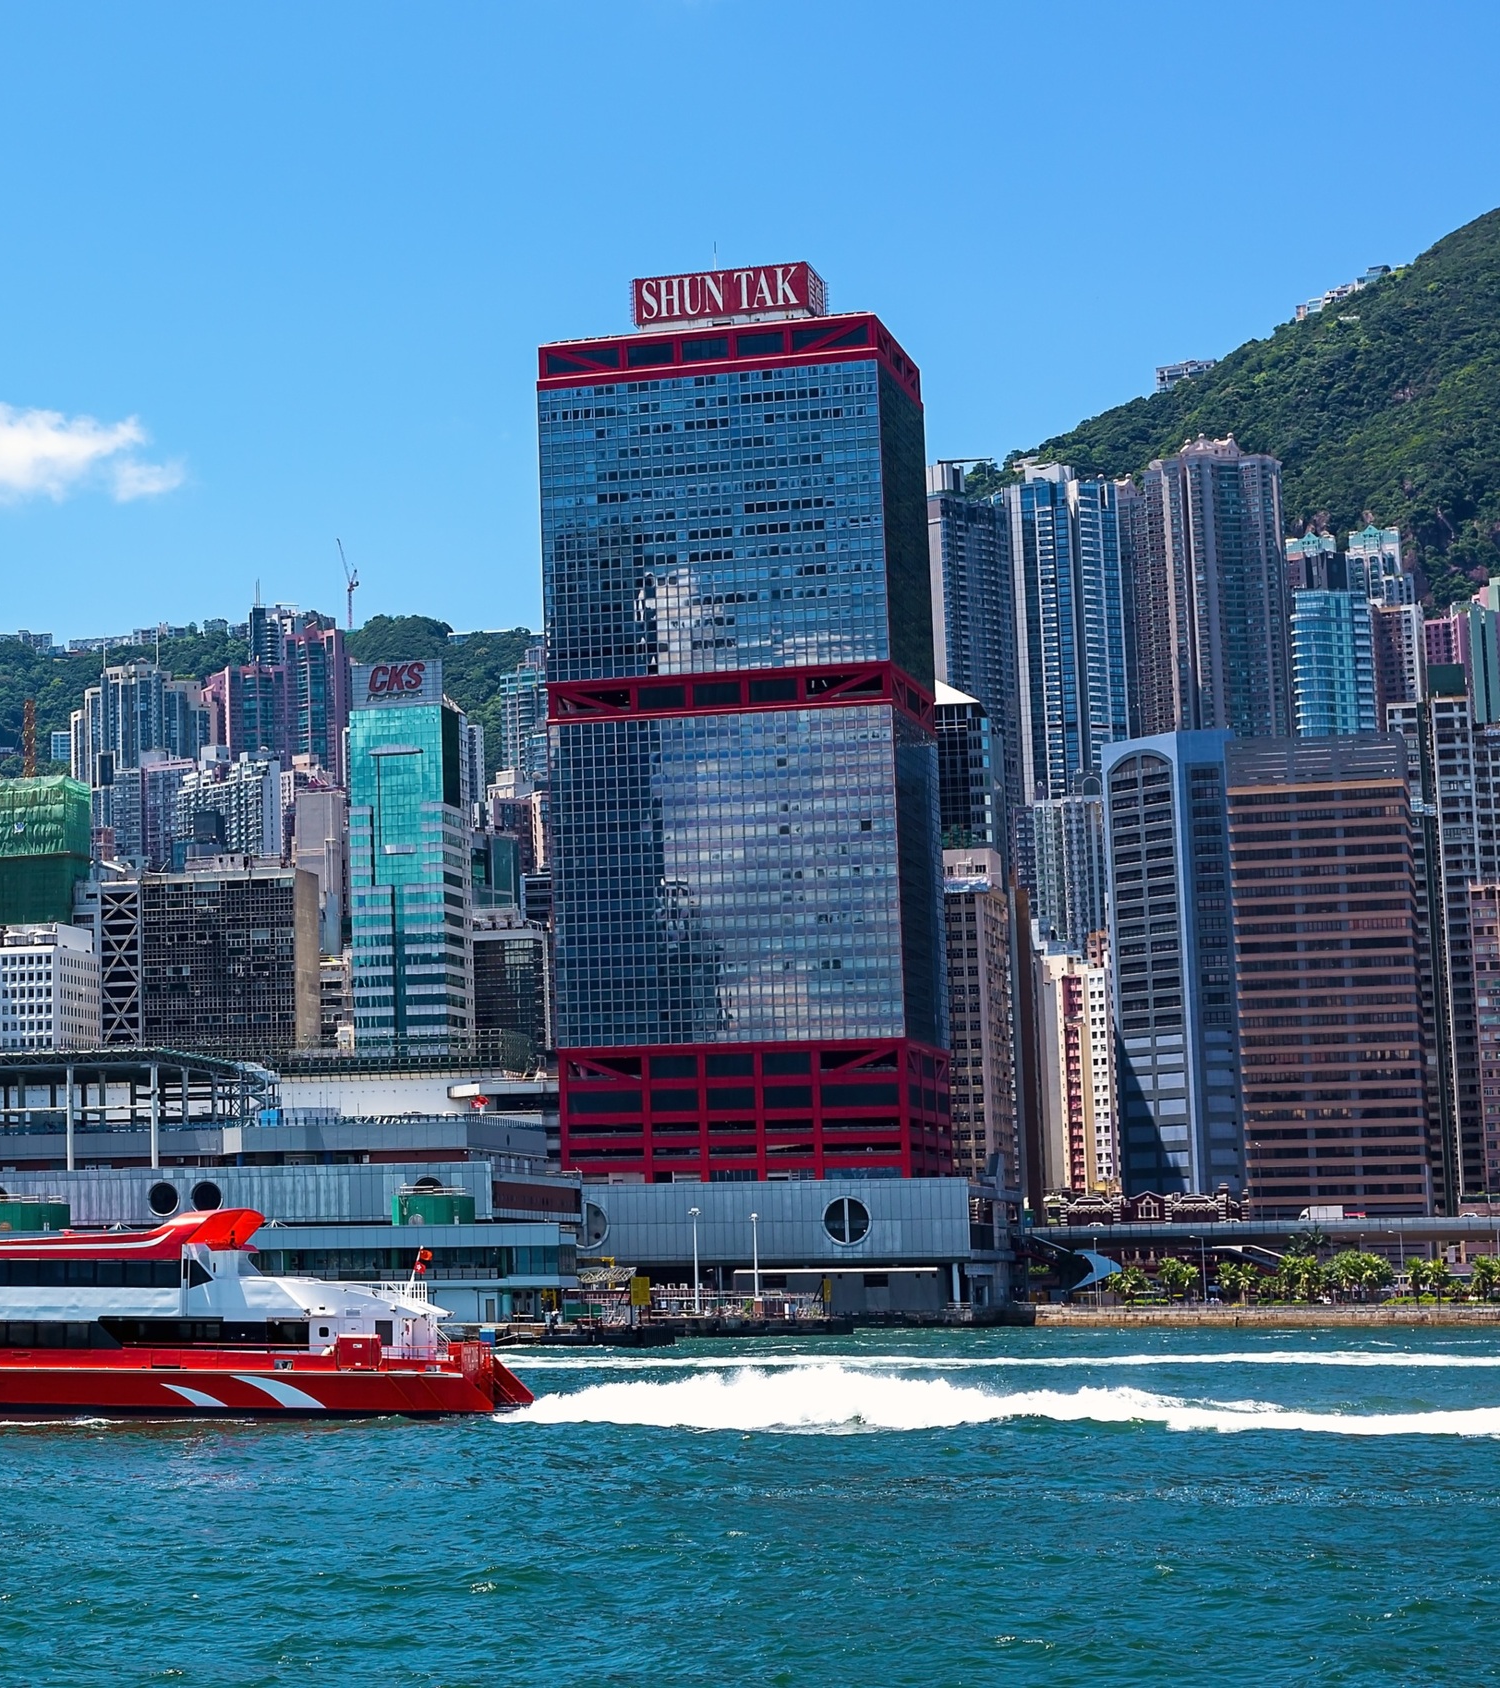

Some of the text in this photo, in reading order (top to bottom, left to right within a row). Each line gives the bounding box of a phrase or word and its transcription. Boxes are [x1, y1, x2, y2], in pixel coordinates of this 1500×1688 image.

[641, 265, 800, 320] SHUN TAK
[368, 661, 426, 693] CKS
